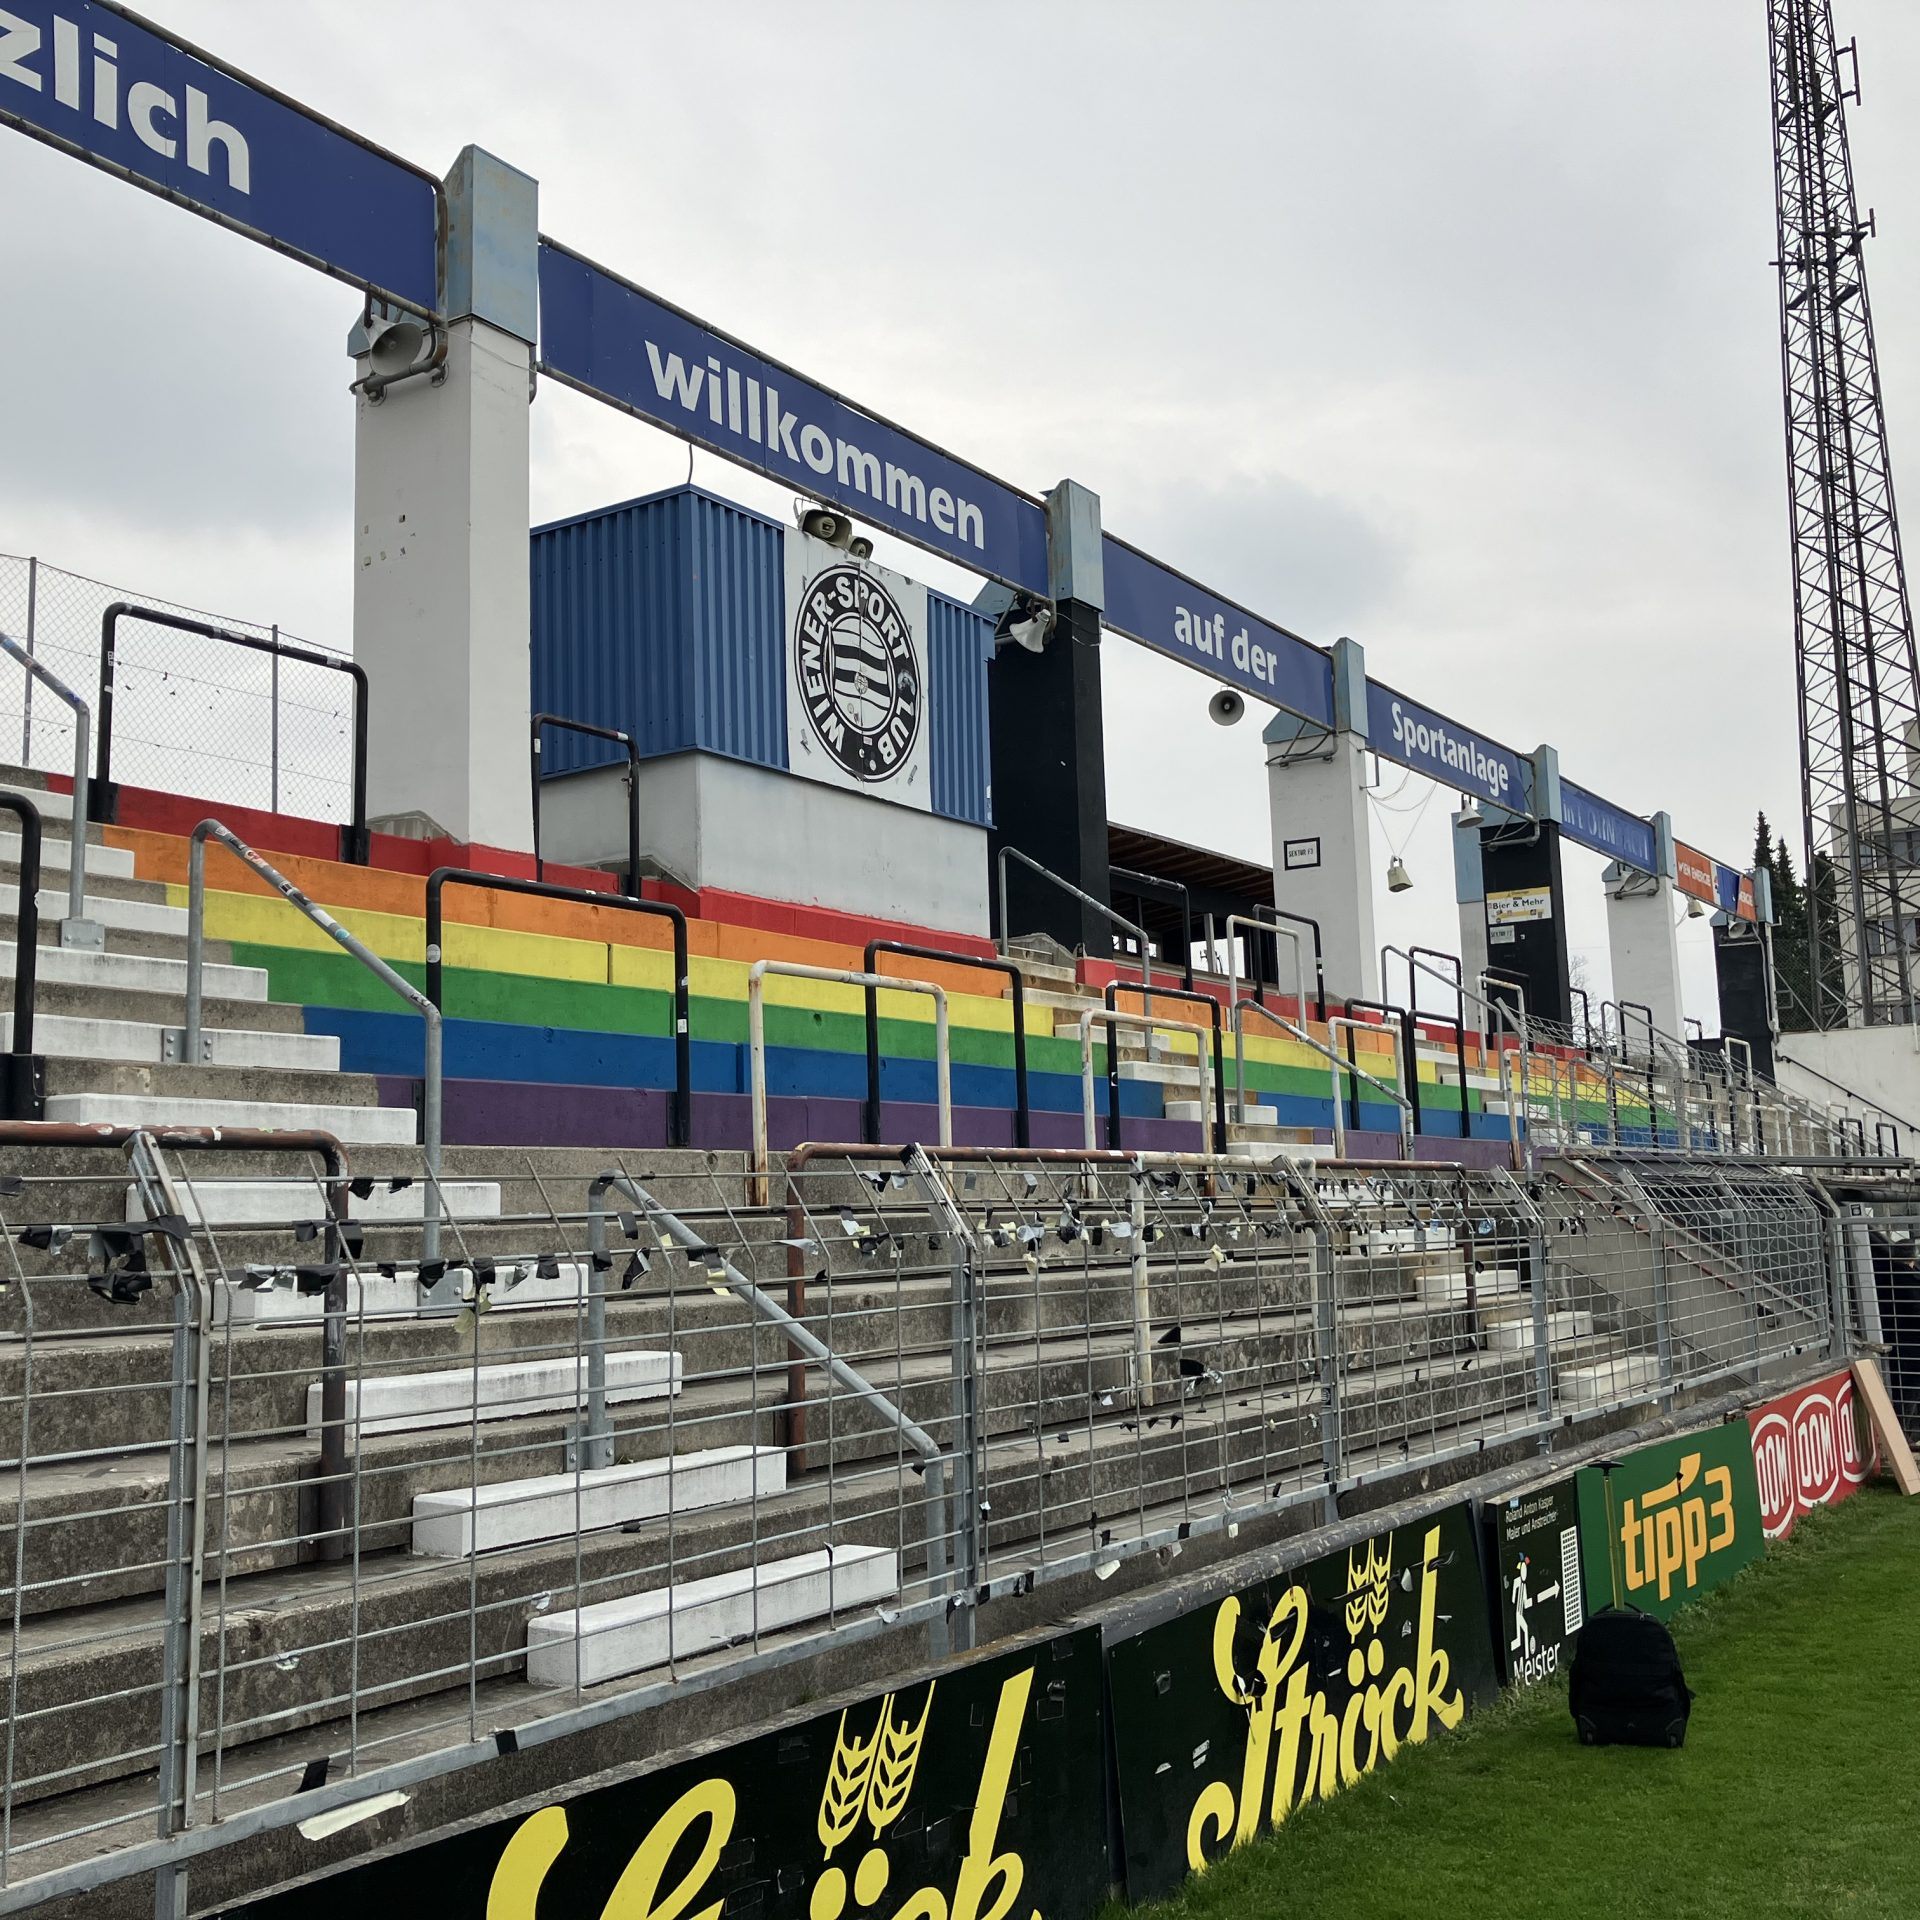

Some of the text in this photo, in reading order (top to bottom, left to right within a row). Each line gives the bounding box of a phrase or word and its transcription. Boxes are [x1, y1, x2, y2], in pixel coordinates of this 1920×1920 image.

[0, 7, 251, 196] zlich
[643, 339, 986, 550] willkommen
[1174, 605, 1278, 686] auf der
[1391, 701, 1509, 798] Sportanlage
[1492, 898, 1545, 910] Bier & Mehr
[1755, 1433, 1790, 1517] DOM
[1797, 1412, 1834, 1488] DOM
[1506, 1526, 1521, 1541] Maler
[1521, 1519, 1531, 1535] und
[1620, 1452, 1735, 1602] tipp3
[1187, 1524, 1464, 1877] Ströck
[1513, 1642, 1560, 1686] Meister
